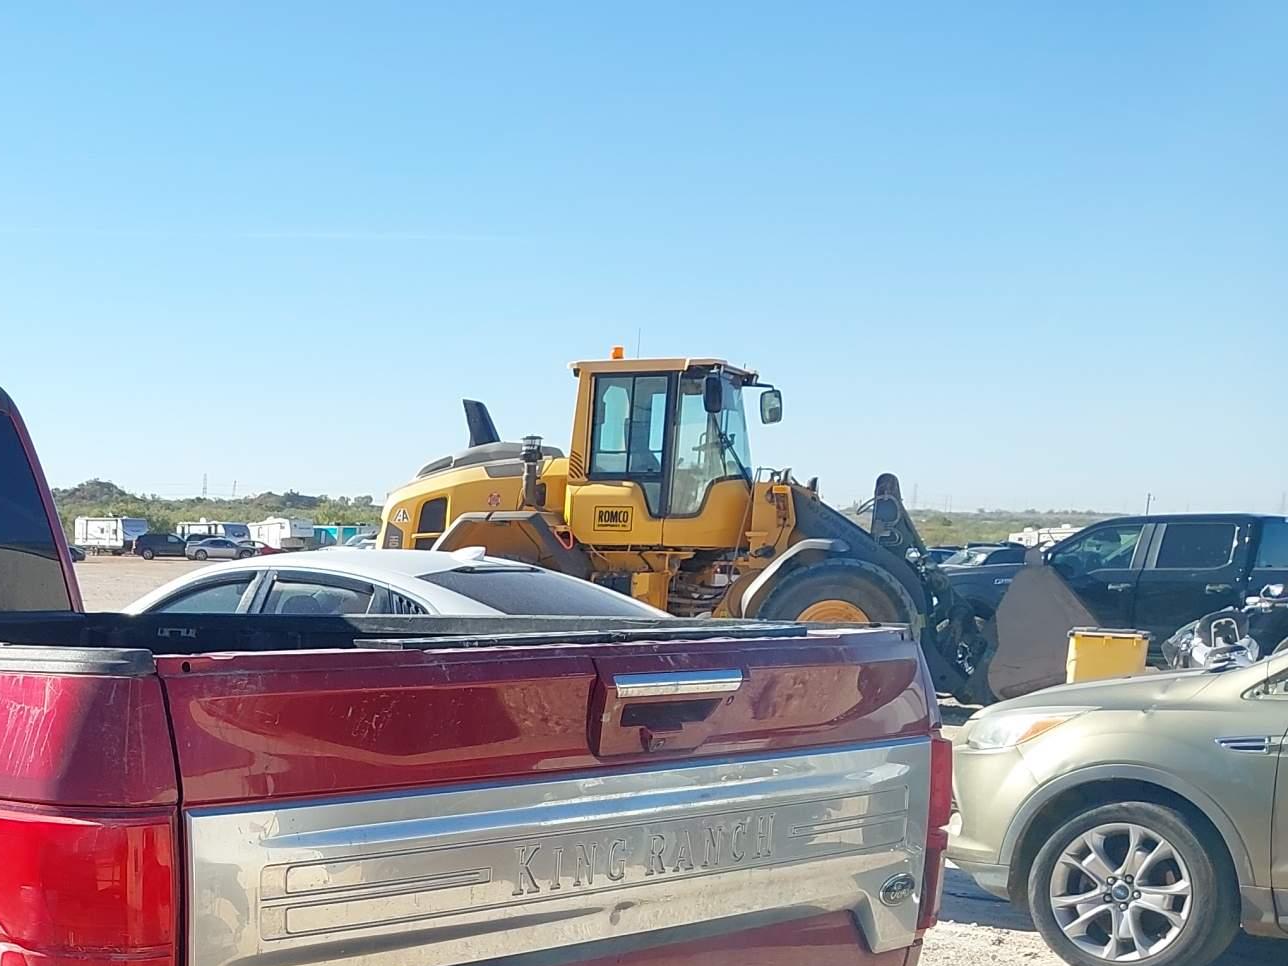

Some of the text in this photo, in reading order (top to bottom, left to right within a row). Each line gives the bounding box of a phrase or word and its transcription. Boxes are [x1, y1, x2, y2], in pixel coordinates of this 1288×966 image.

[598, 510, 629, 523] ROMCO
[512, 812, 777, 896] KING RANCH
